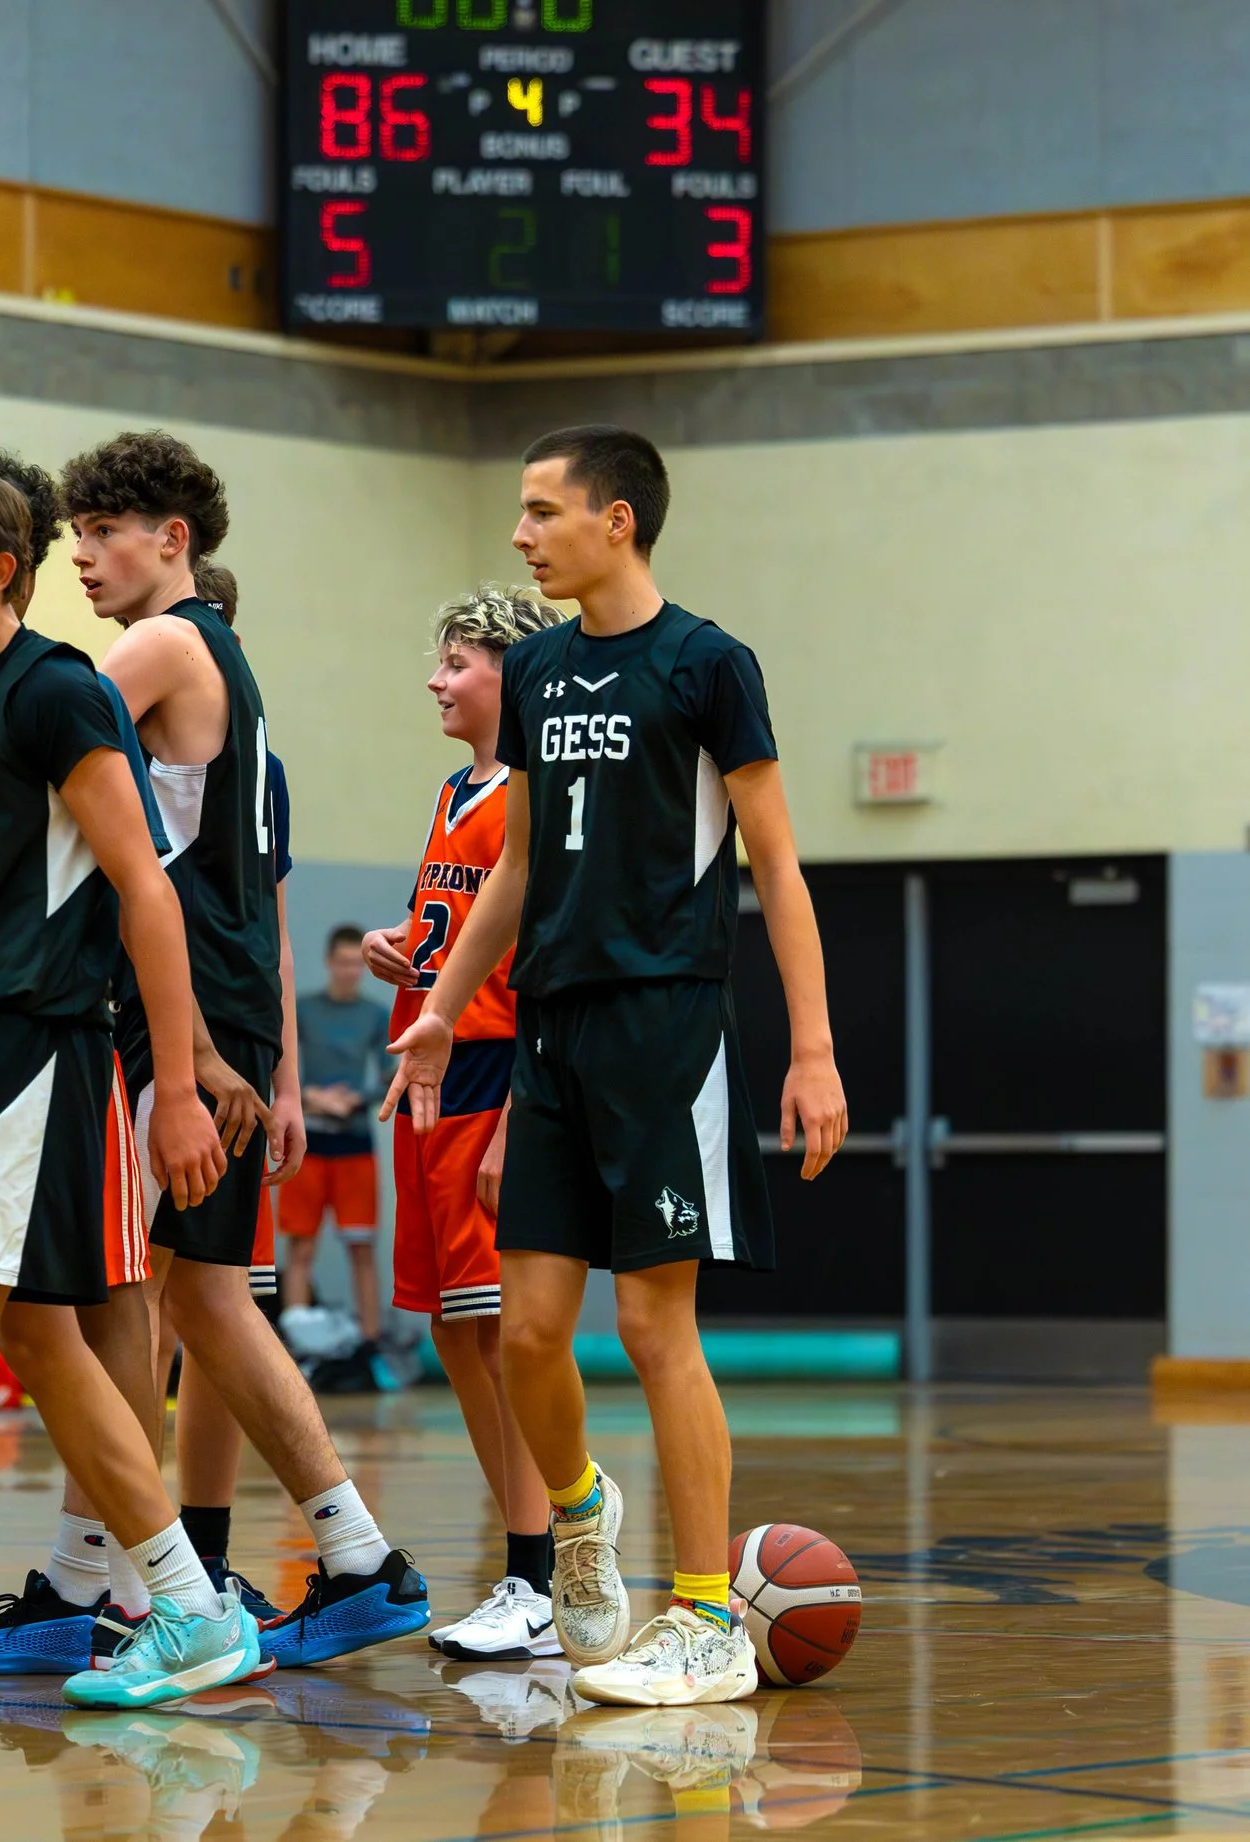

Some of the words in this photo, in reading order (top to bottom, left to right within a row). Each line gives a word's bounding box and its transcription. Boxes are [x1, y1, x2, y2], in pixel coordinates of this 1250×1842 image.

[308, 33, 408, 67] HOME
[478, 46, 574, 72] PERIOD
[628, 38, 740, 72] GUEST
[320, 72, 431, 161] 86
[507, 77, 543, 127] 4
[644, 77, 751, 166] 34
[479, 131, 571, 160] BONUS
[291, 164, 378, 193] FOULS
[432, 166, 534, 196] PLAYER
[560, 168, 631, 197] FOUL
[671, 171, 757, 199] FOULS
[319, 200, 372, 288] 5
[704, 205, 751, 294] 3
[447, 296, 539, 325] MATCH
[661, 300, 750, 328] SCORE
[540, 714, 632, 762] GESS
[565, 777, 586, 850] 1
[405, 901, 450, 991] 2
